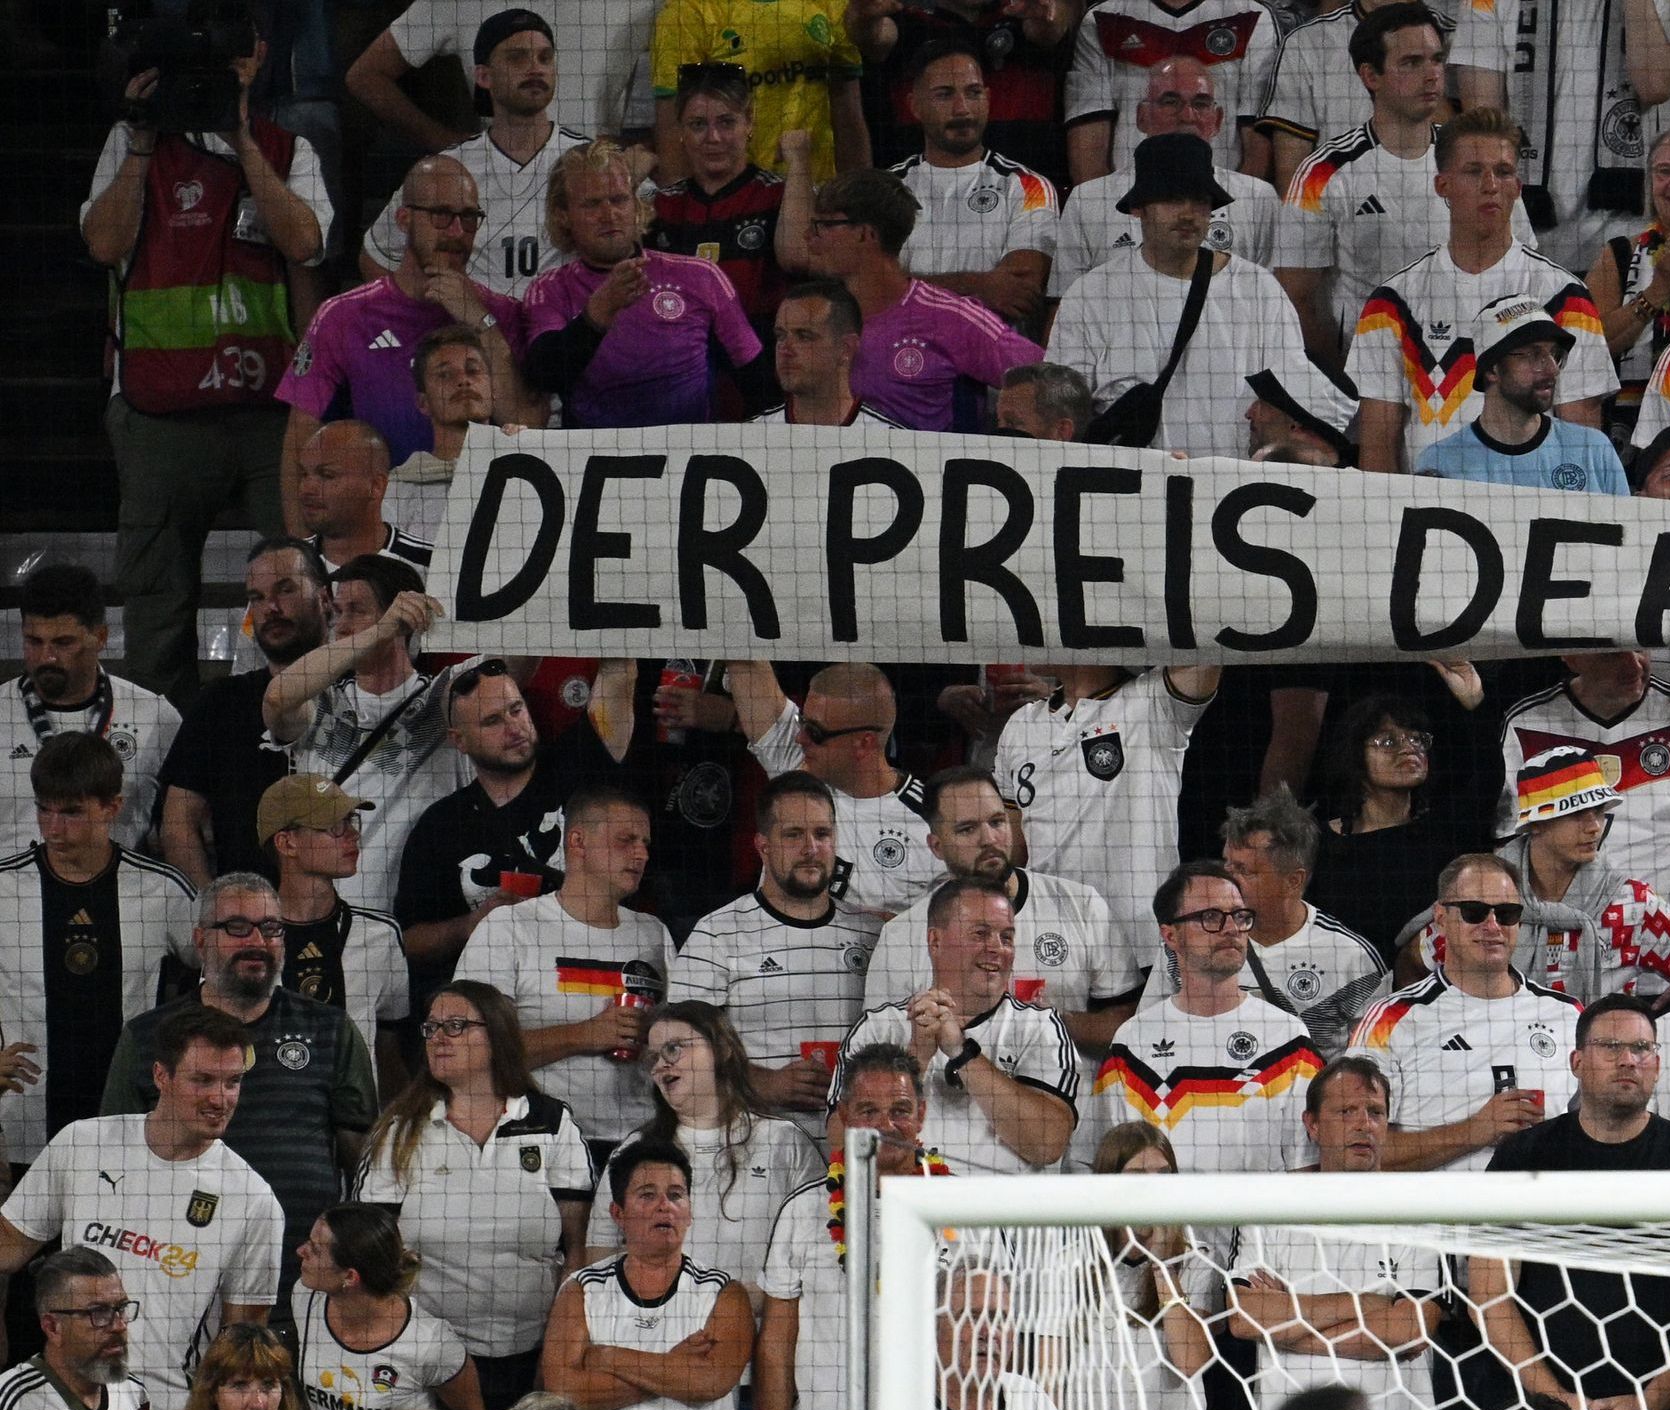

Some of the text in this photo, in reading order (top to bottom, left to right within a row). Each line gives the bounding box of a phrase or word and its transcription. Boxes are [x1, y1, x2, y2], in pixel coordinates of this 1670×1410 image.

[501, 235, 539, 279] 10
[456, 454, 780, 640] DER
[826, 458, 1318, 653] PREIS
[83, 1221, 199, 1269] CHECK24
